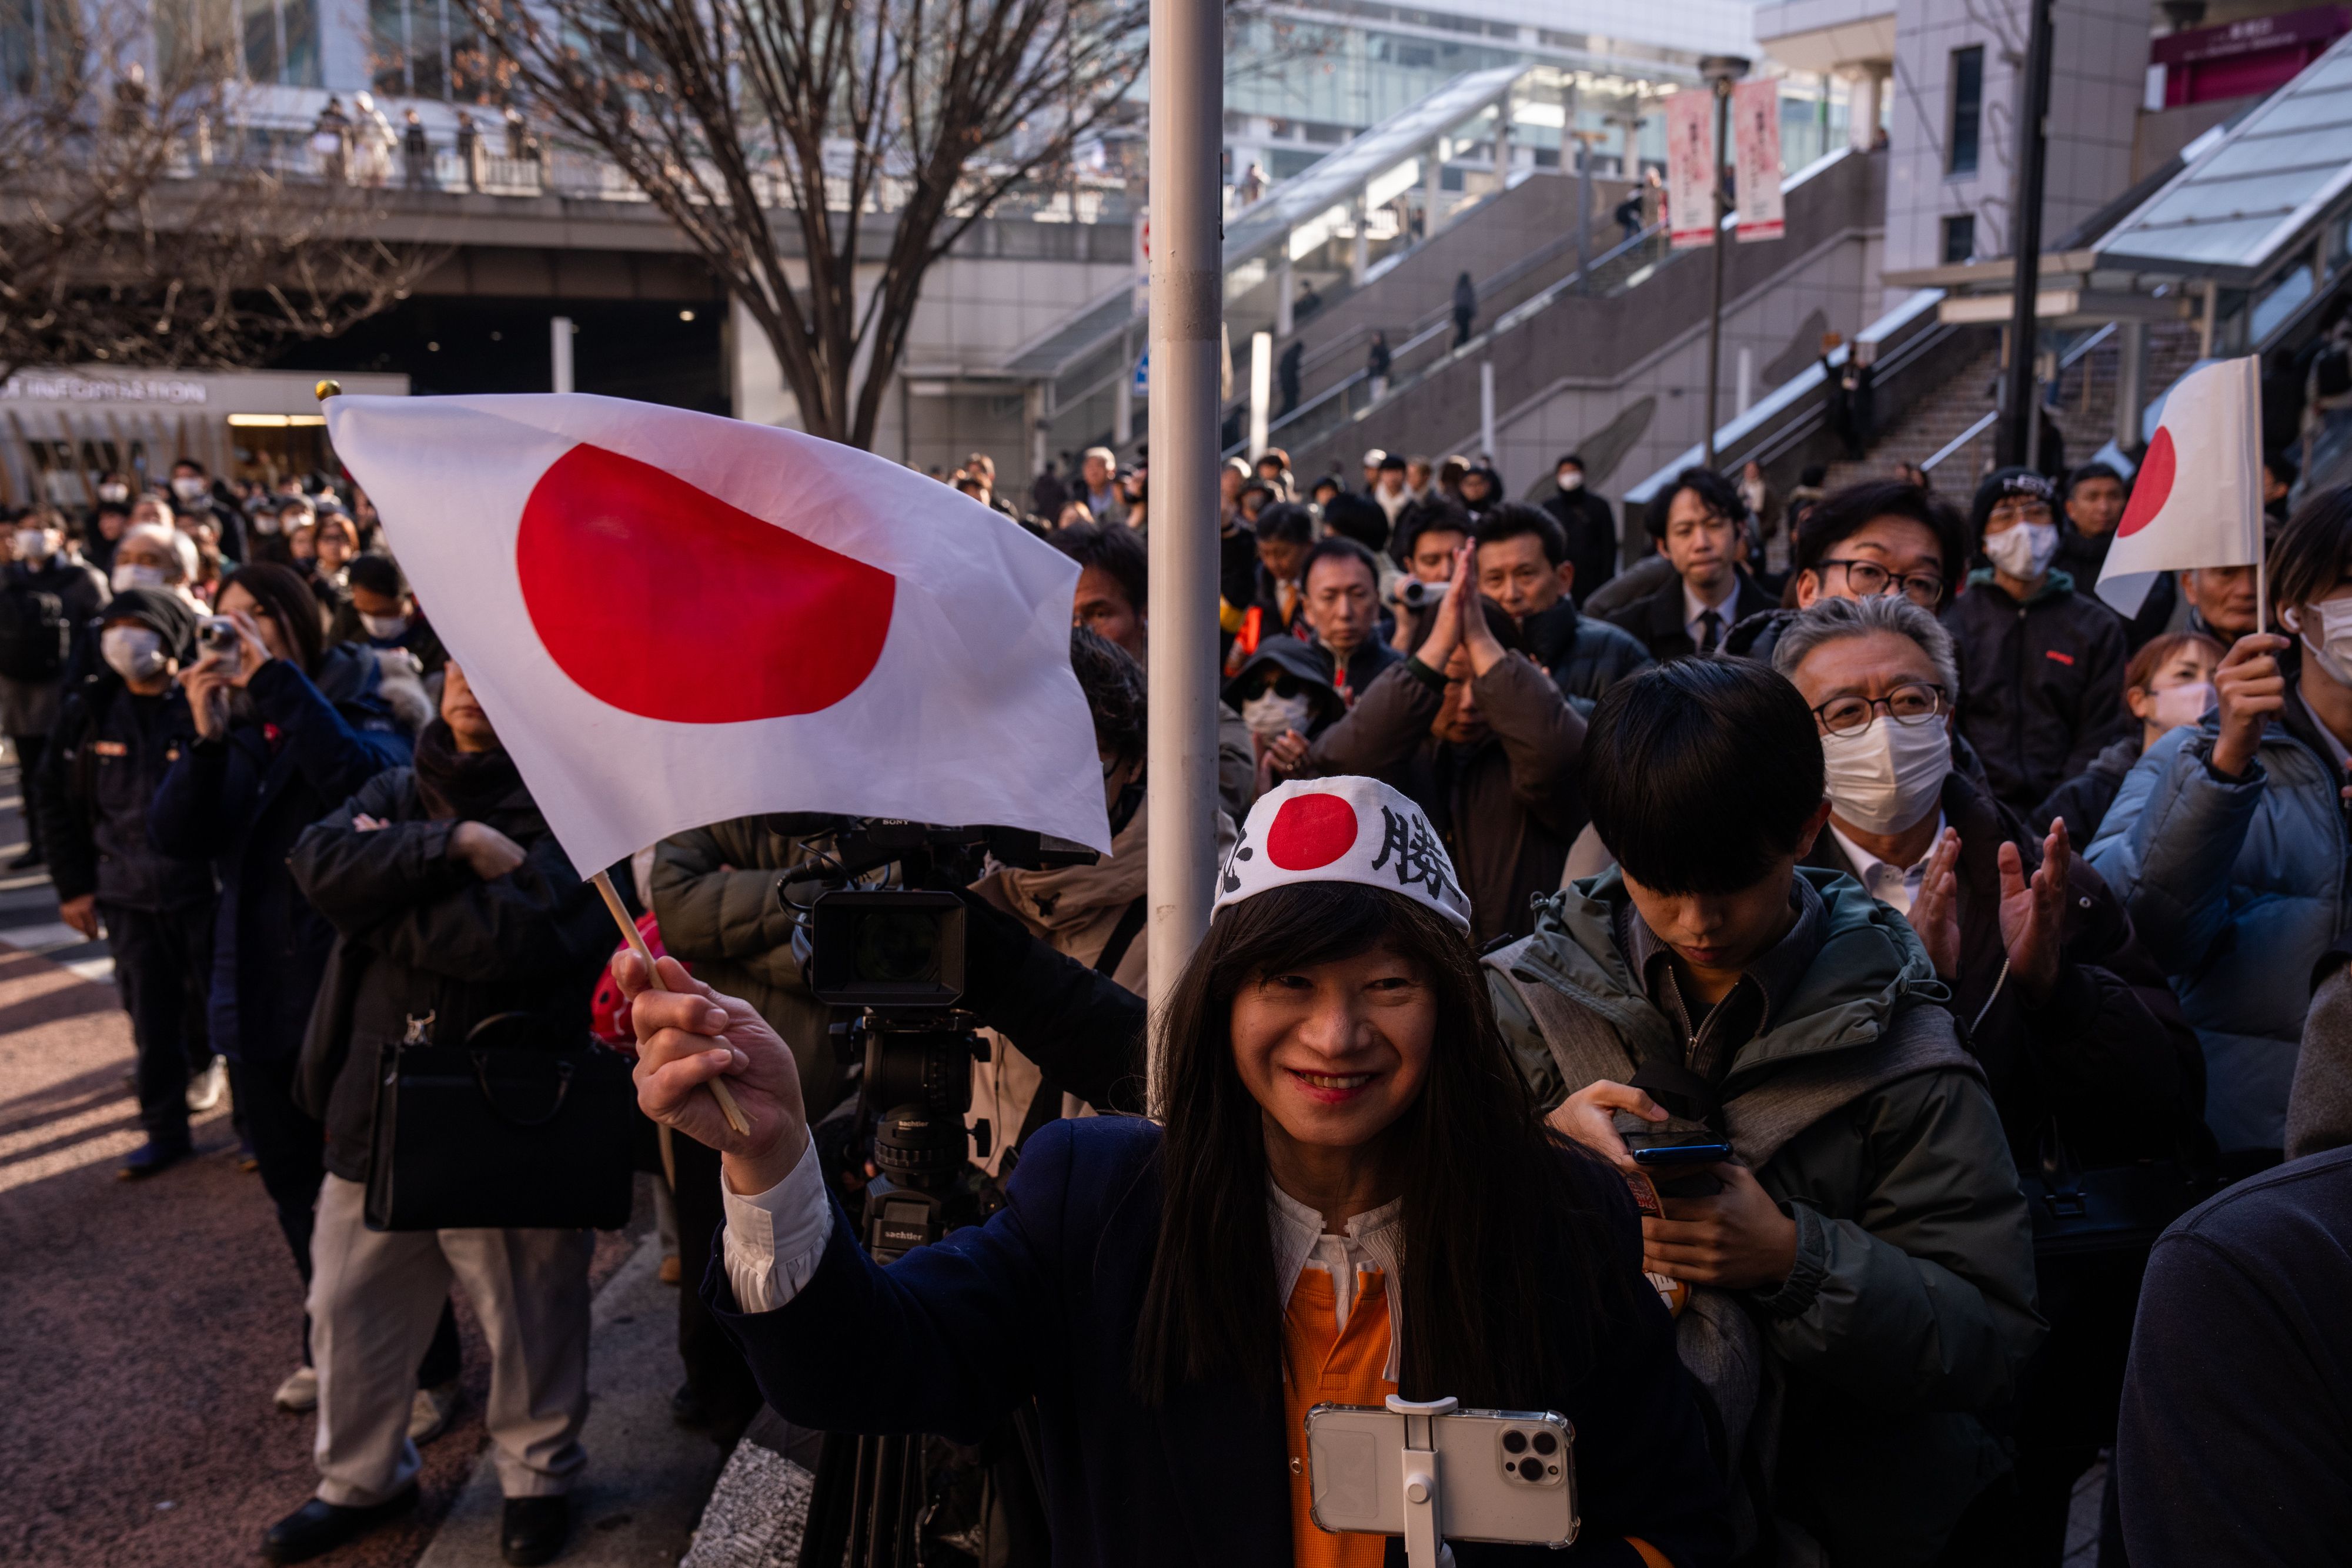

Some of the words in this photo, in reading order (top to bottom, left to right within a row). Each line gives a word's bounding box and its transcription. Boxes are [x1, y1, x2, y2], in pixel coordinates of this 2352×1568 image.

[27, 379, 206, 404] INFORMATION
[1371, 805, 1462, 904] 勝
[884, 1231, 923, 1241] sachtler
